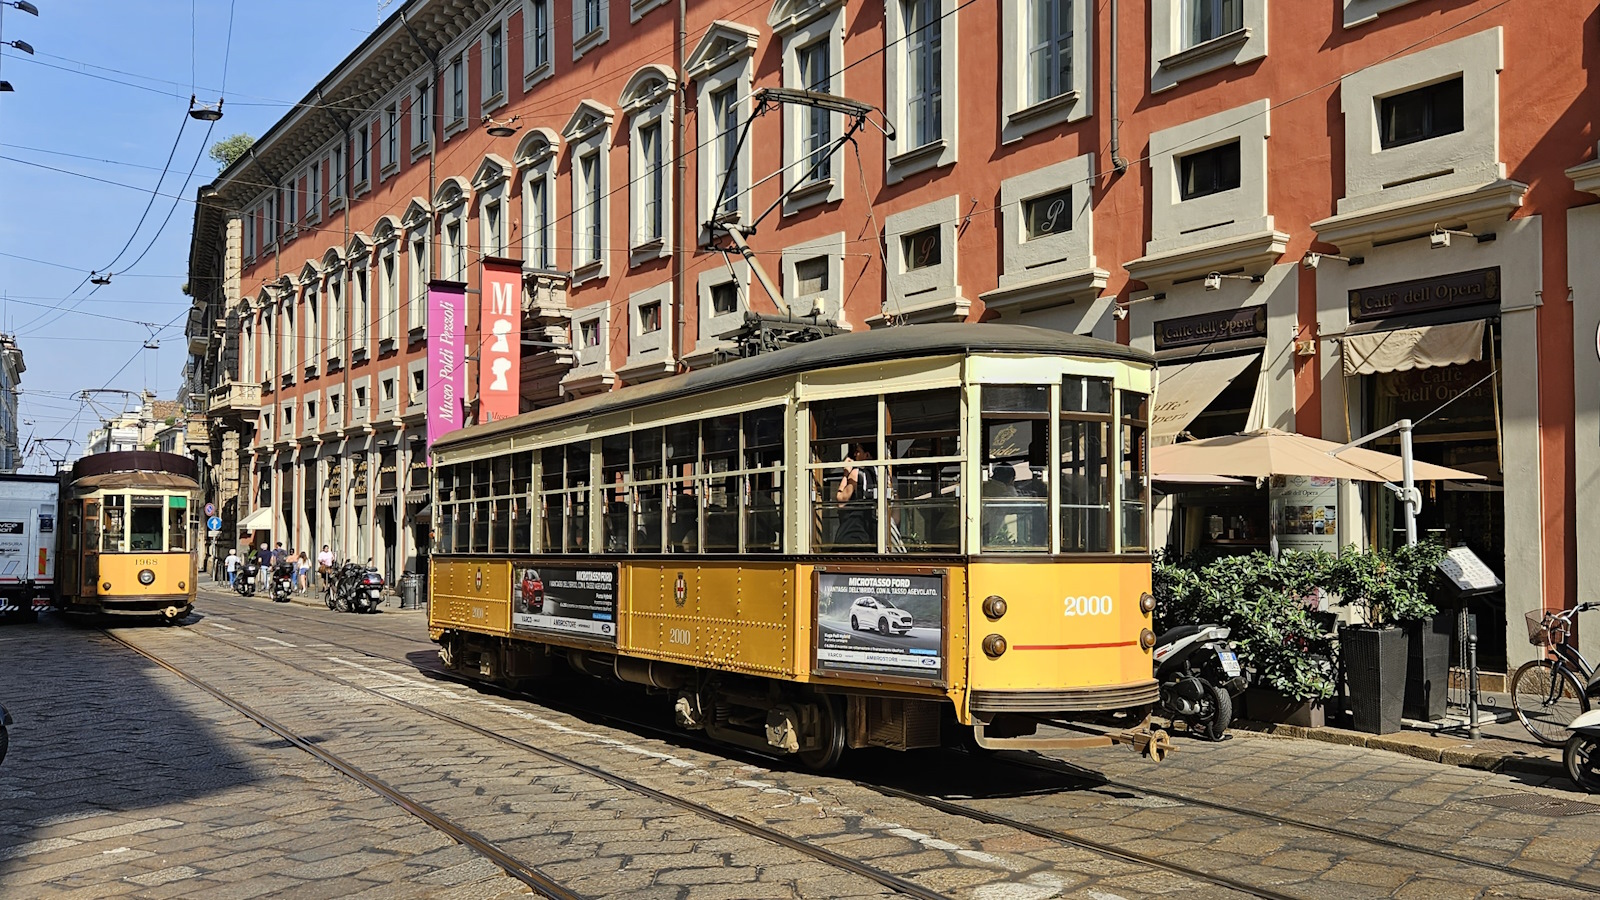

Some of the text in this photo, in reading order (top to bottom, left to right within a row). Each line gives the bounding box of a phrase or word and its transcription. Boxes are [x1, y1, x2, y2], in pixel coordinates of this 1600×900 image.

[490, 282, 514, 316] M
[1364, 292, 1398, 308] Caff
[1436, 284, 1480, 301] Opera
[439, 300, 454, 424] Museo Poldi Pezzoli
[1421, 368, 1462, 383] Caffè
[849, 578, 910, 588] MICROTASSO FORD
[1064, 595, 1112, 616] 2000
[670, 628, 690, 645] 2000
